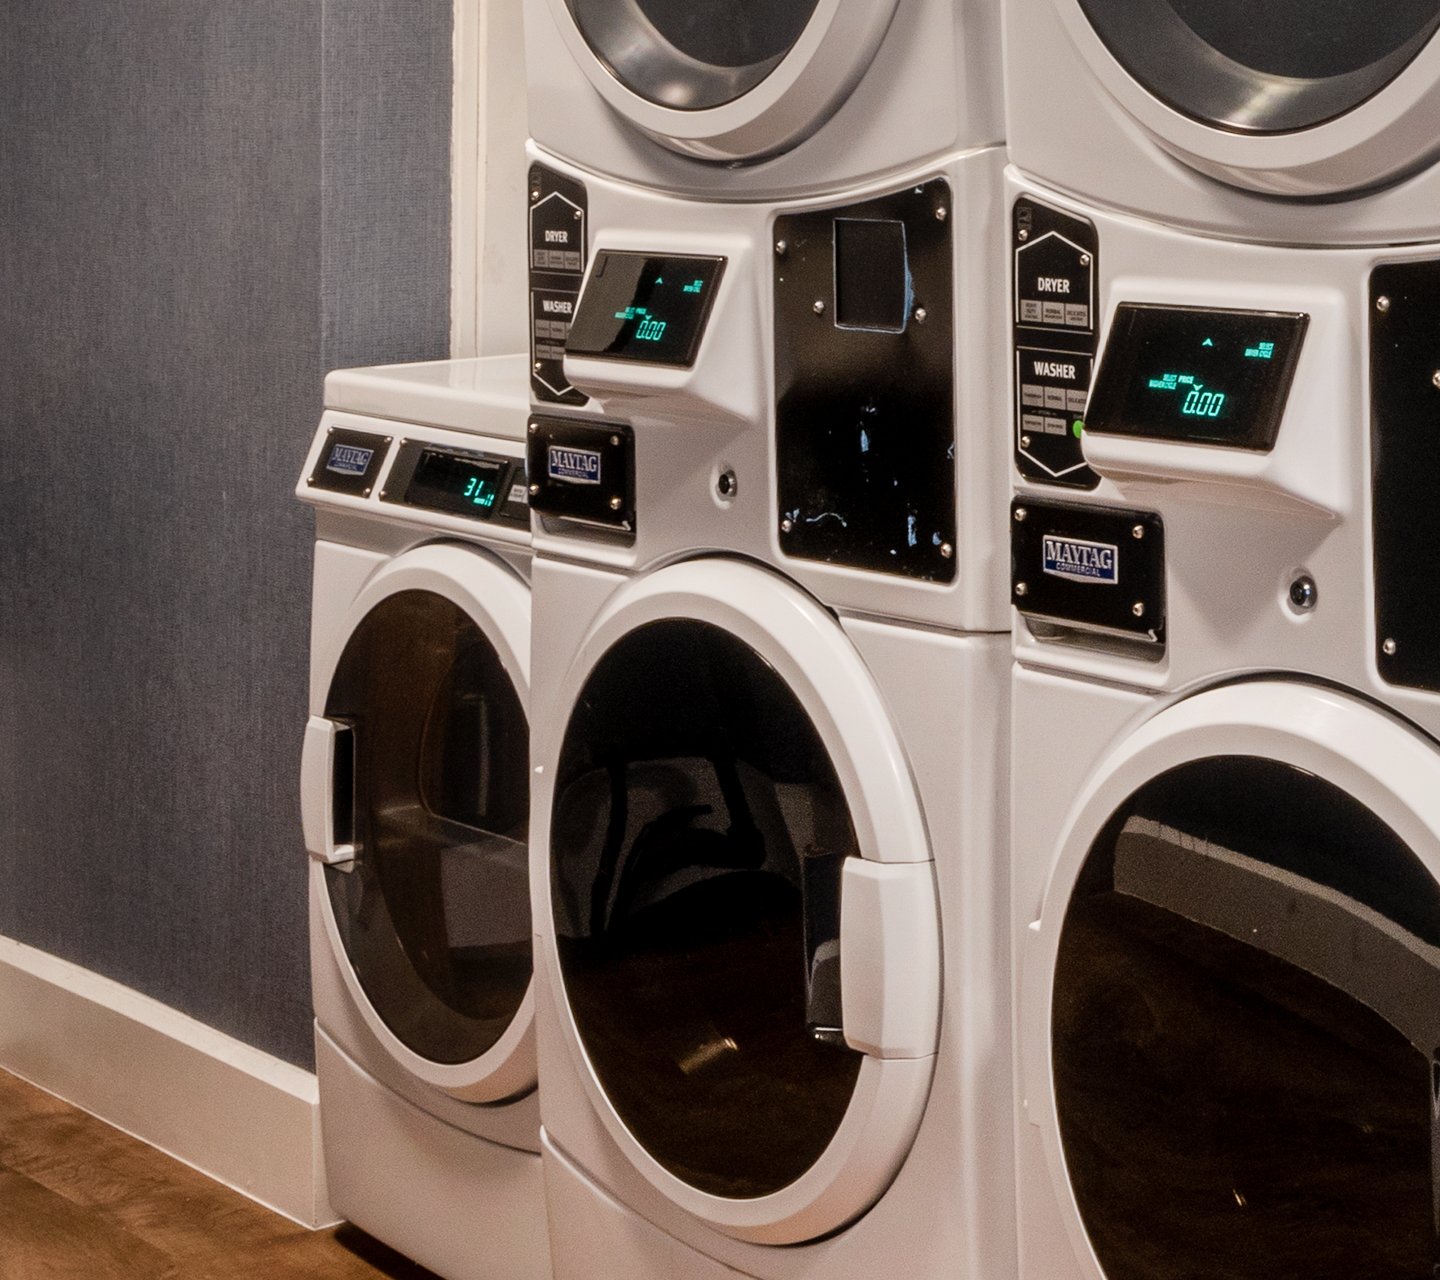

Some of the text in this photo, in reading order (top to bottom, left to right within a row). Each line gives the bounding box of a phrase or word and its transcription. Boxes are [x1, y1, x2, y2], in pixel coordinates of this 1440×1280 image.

[545, 230, 568, 243] DRYER
[1037, 277, 1070, 294] DRYER
[542, 299, 573, 314] WASHER
[1034, 361, 1076, 379] WASHER
[1182, 391, 1225, 417] 0.00
[552, 450, 597, 472] MAYTAG
[1046, 541, 1113, 570] MAYTAG
